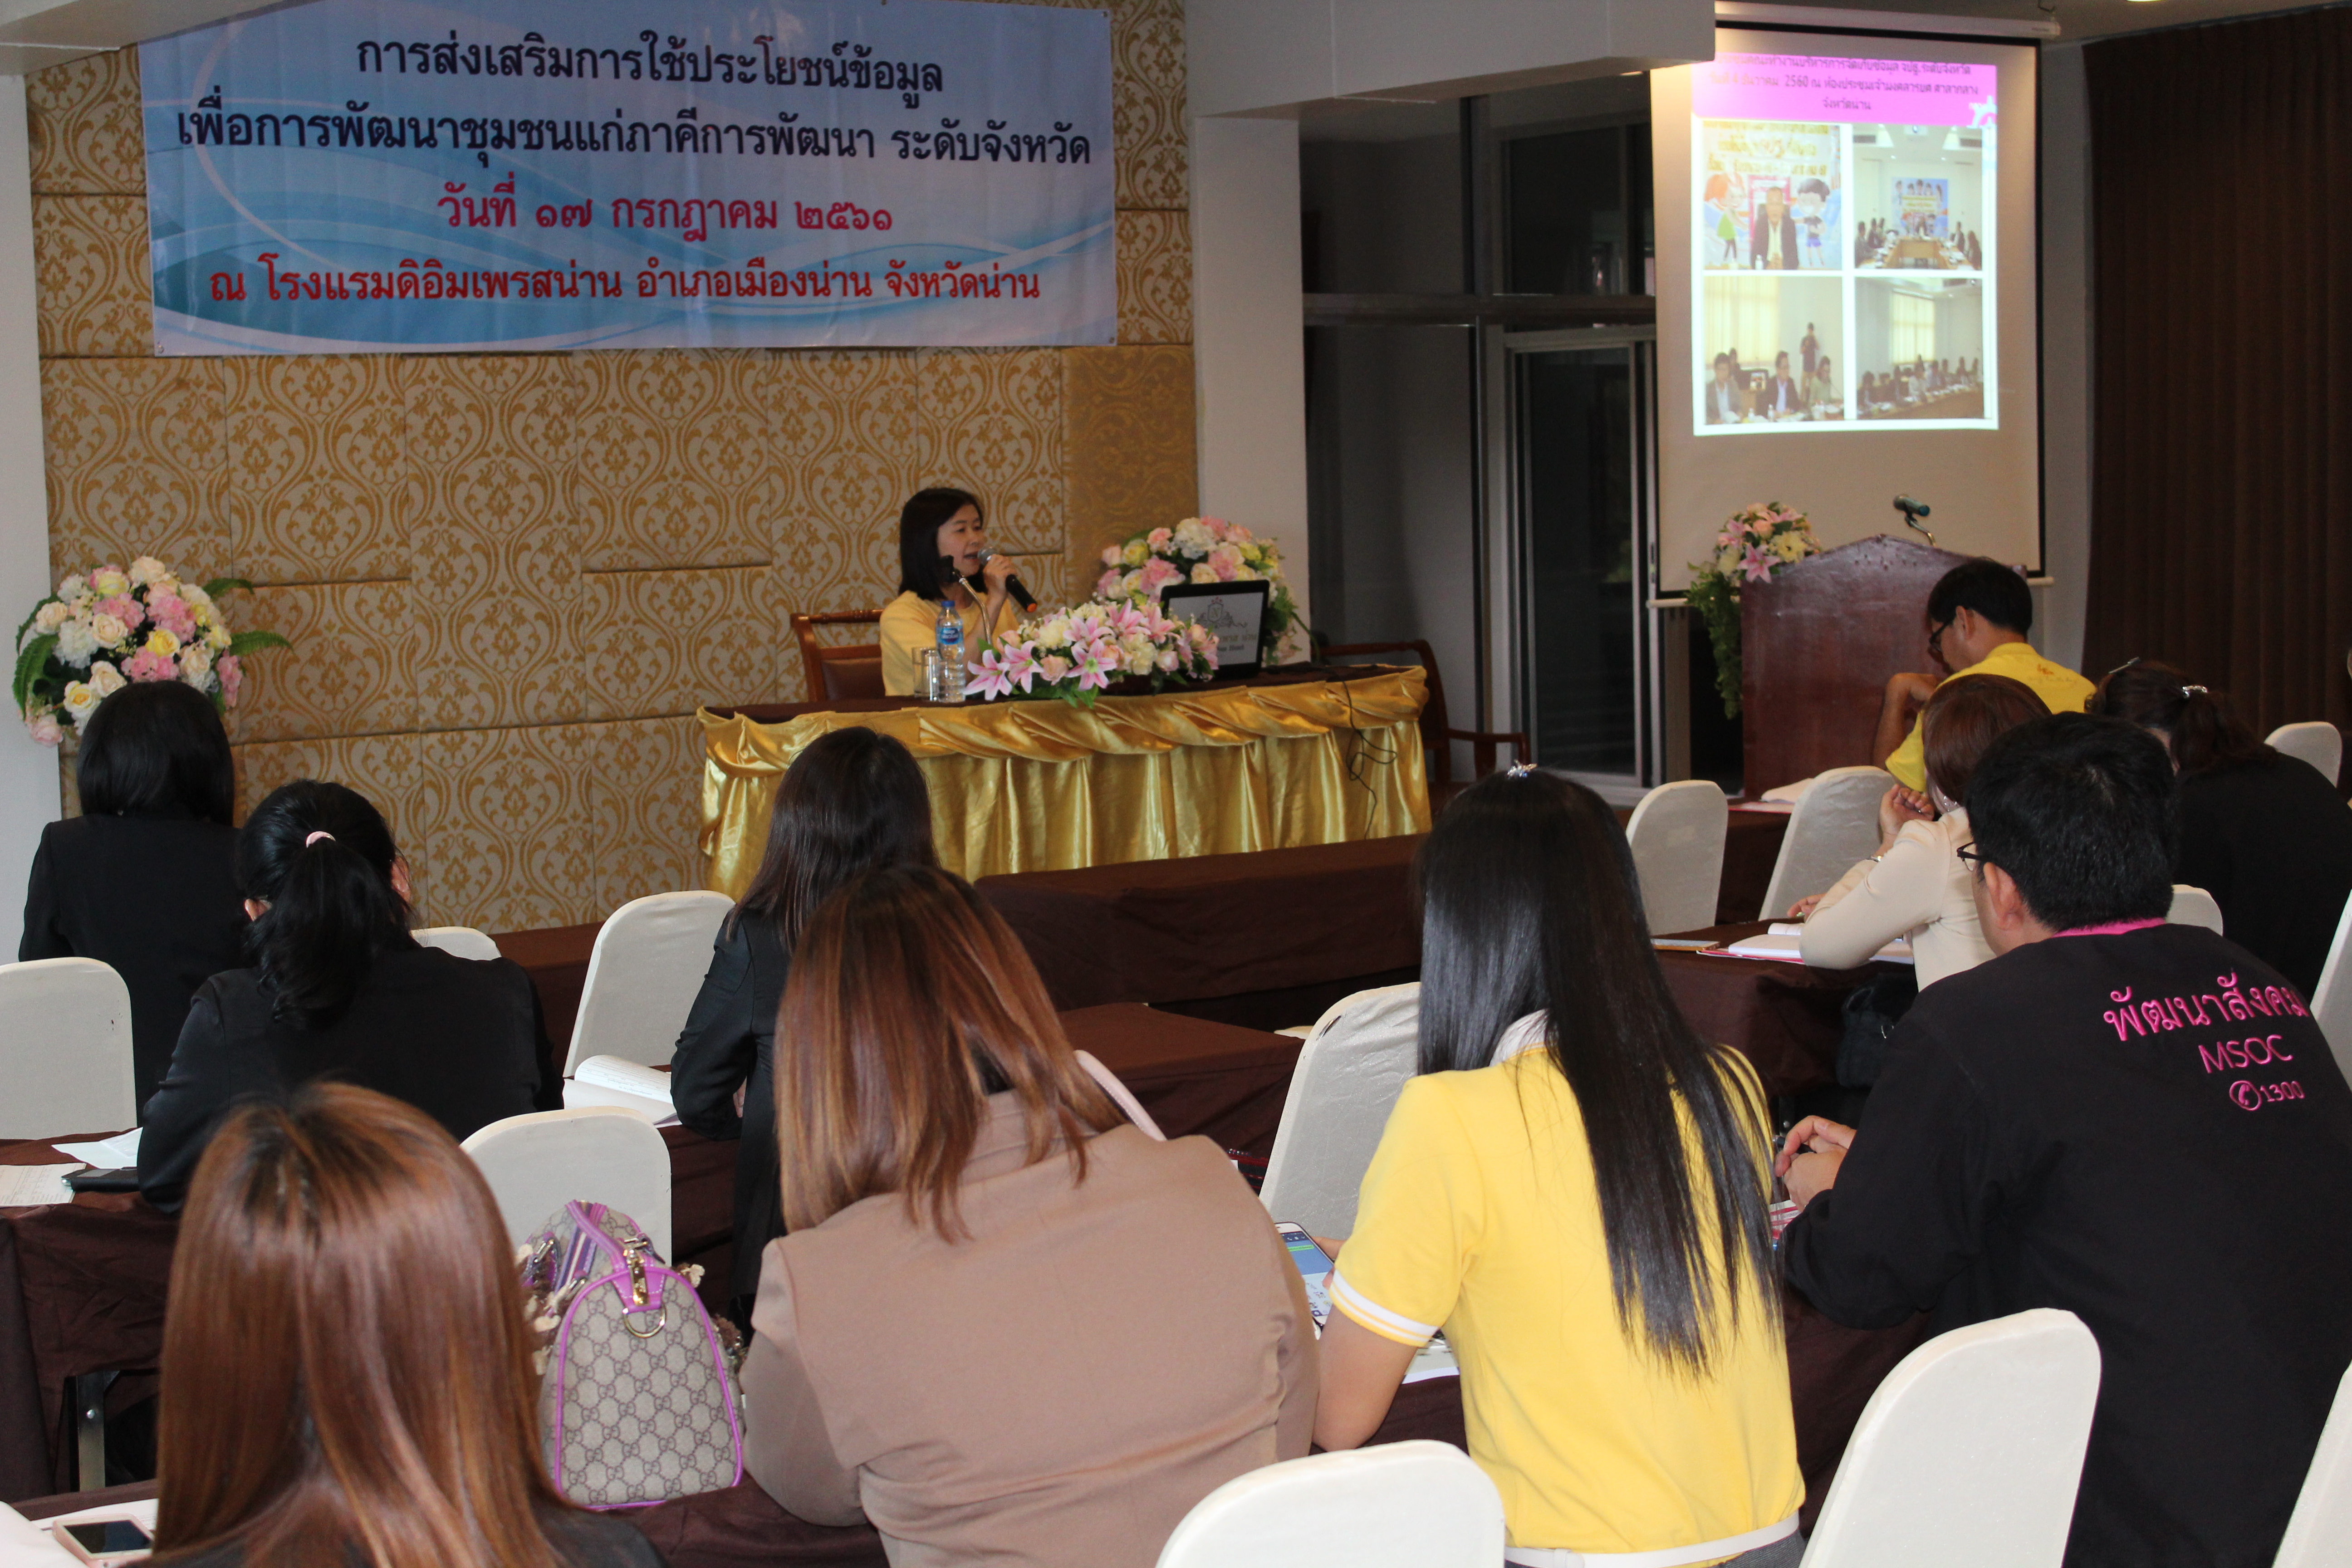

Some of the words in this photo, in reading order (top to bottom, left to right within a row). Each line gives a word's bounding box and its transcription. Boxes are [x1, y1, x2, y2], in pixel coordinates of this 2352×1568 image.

[357, 29, 943, 108] การส่งเสริมการใช้ประโยชน์ข้อมูล
[1785, 74, 1809, 88] 2560
[177, 85, 875, 168] เพื่อการพัฒนาชุมชนแก่ภาคีการพัฒนา
[891, 118, 1091, 164] ระดับจังหวัด
[438, 171, 517, 229] วันที่
[535, 196, 593, 228] ๑๗
[612, 196, 778, 242] กรกฎาคม
[794, 199, 893, 230] ๒๕๖๑
[210, 271, 246, 301] ณ
[258, 253, 622, 301] โรงแรมดิอิมเพรสน่าน
[637, 256, 872, 298] อำเภอเมืองน่าน
[884, 260, 1040, 299] จังหวัดน่าน
[2103, 970, 2310, 1042] พัฒนาสังคม
[2198, 1034, 2294, 1074] MSOC
[2260, 1081, 2306, 1103] 1300
